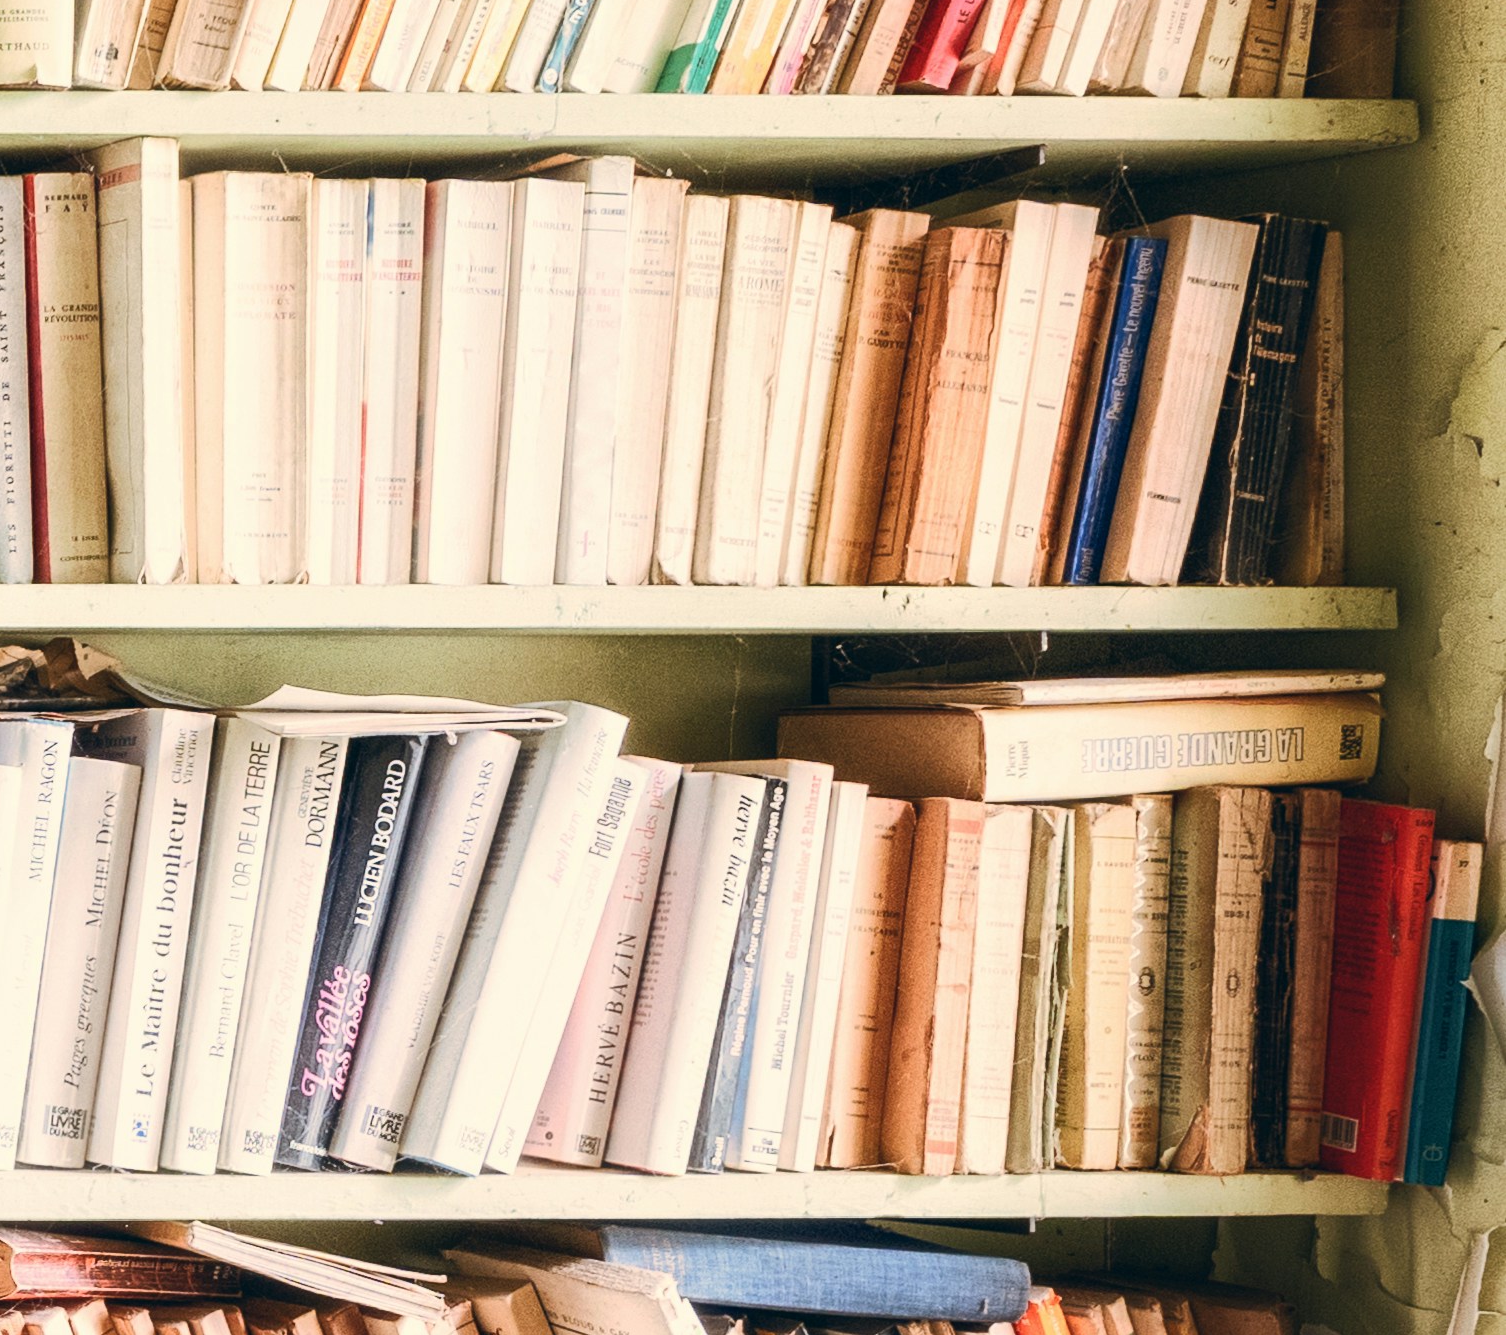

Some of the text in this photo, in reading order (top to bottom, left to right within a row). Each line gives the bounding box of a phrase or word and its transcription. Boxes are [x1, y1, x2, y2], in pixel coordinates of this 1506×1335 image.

[956, 10, 969, 24] LE
[1, 380, 11, 401] DE
[2, 420, 14, 504] FIORETTI
[8, 523, 17, 554] LES
[1081, 727, 1305, 773] LA GRANDE GUERRE
[354, 759, 407, 928] LUCIEN BODARD
[135, 797, 188, 1098] Le Maître du bonheur
[300, 964, 353, 1098] La vallée
[588, 932, 638, 1105] HERVÉ BAZIN
